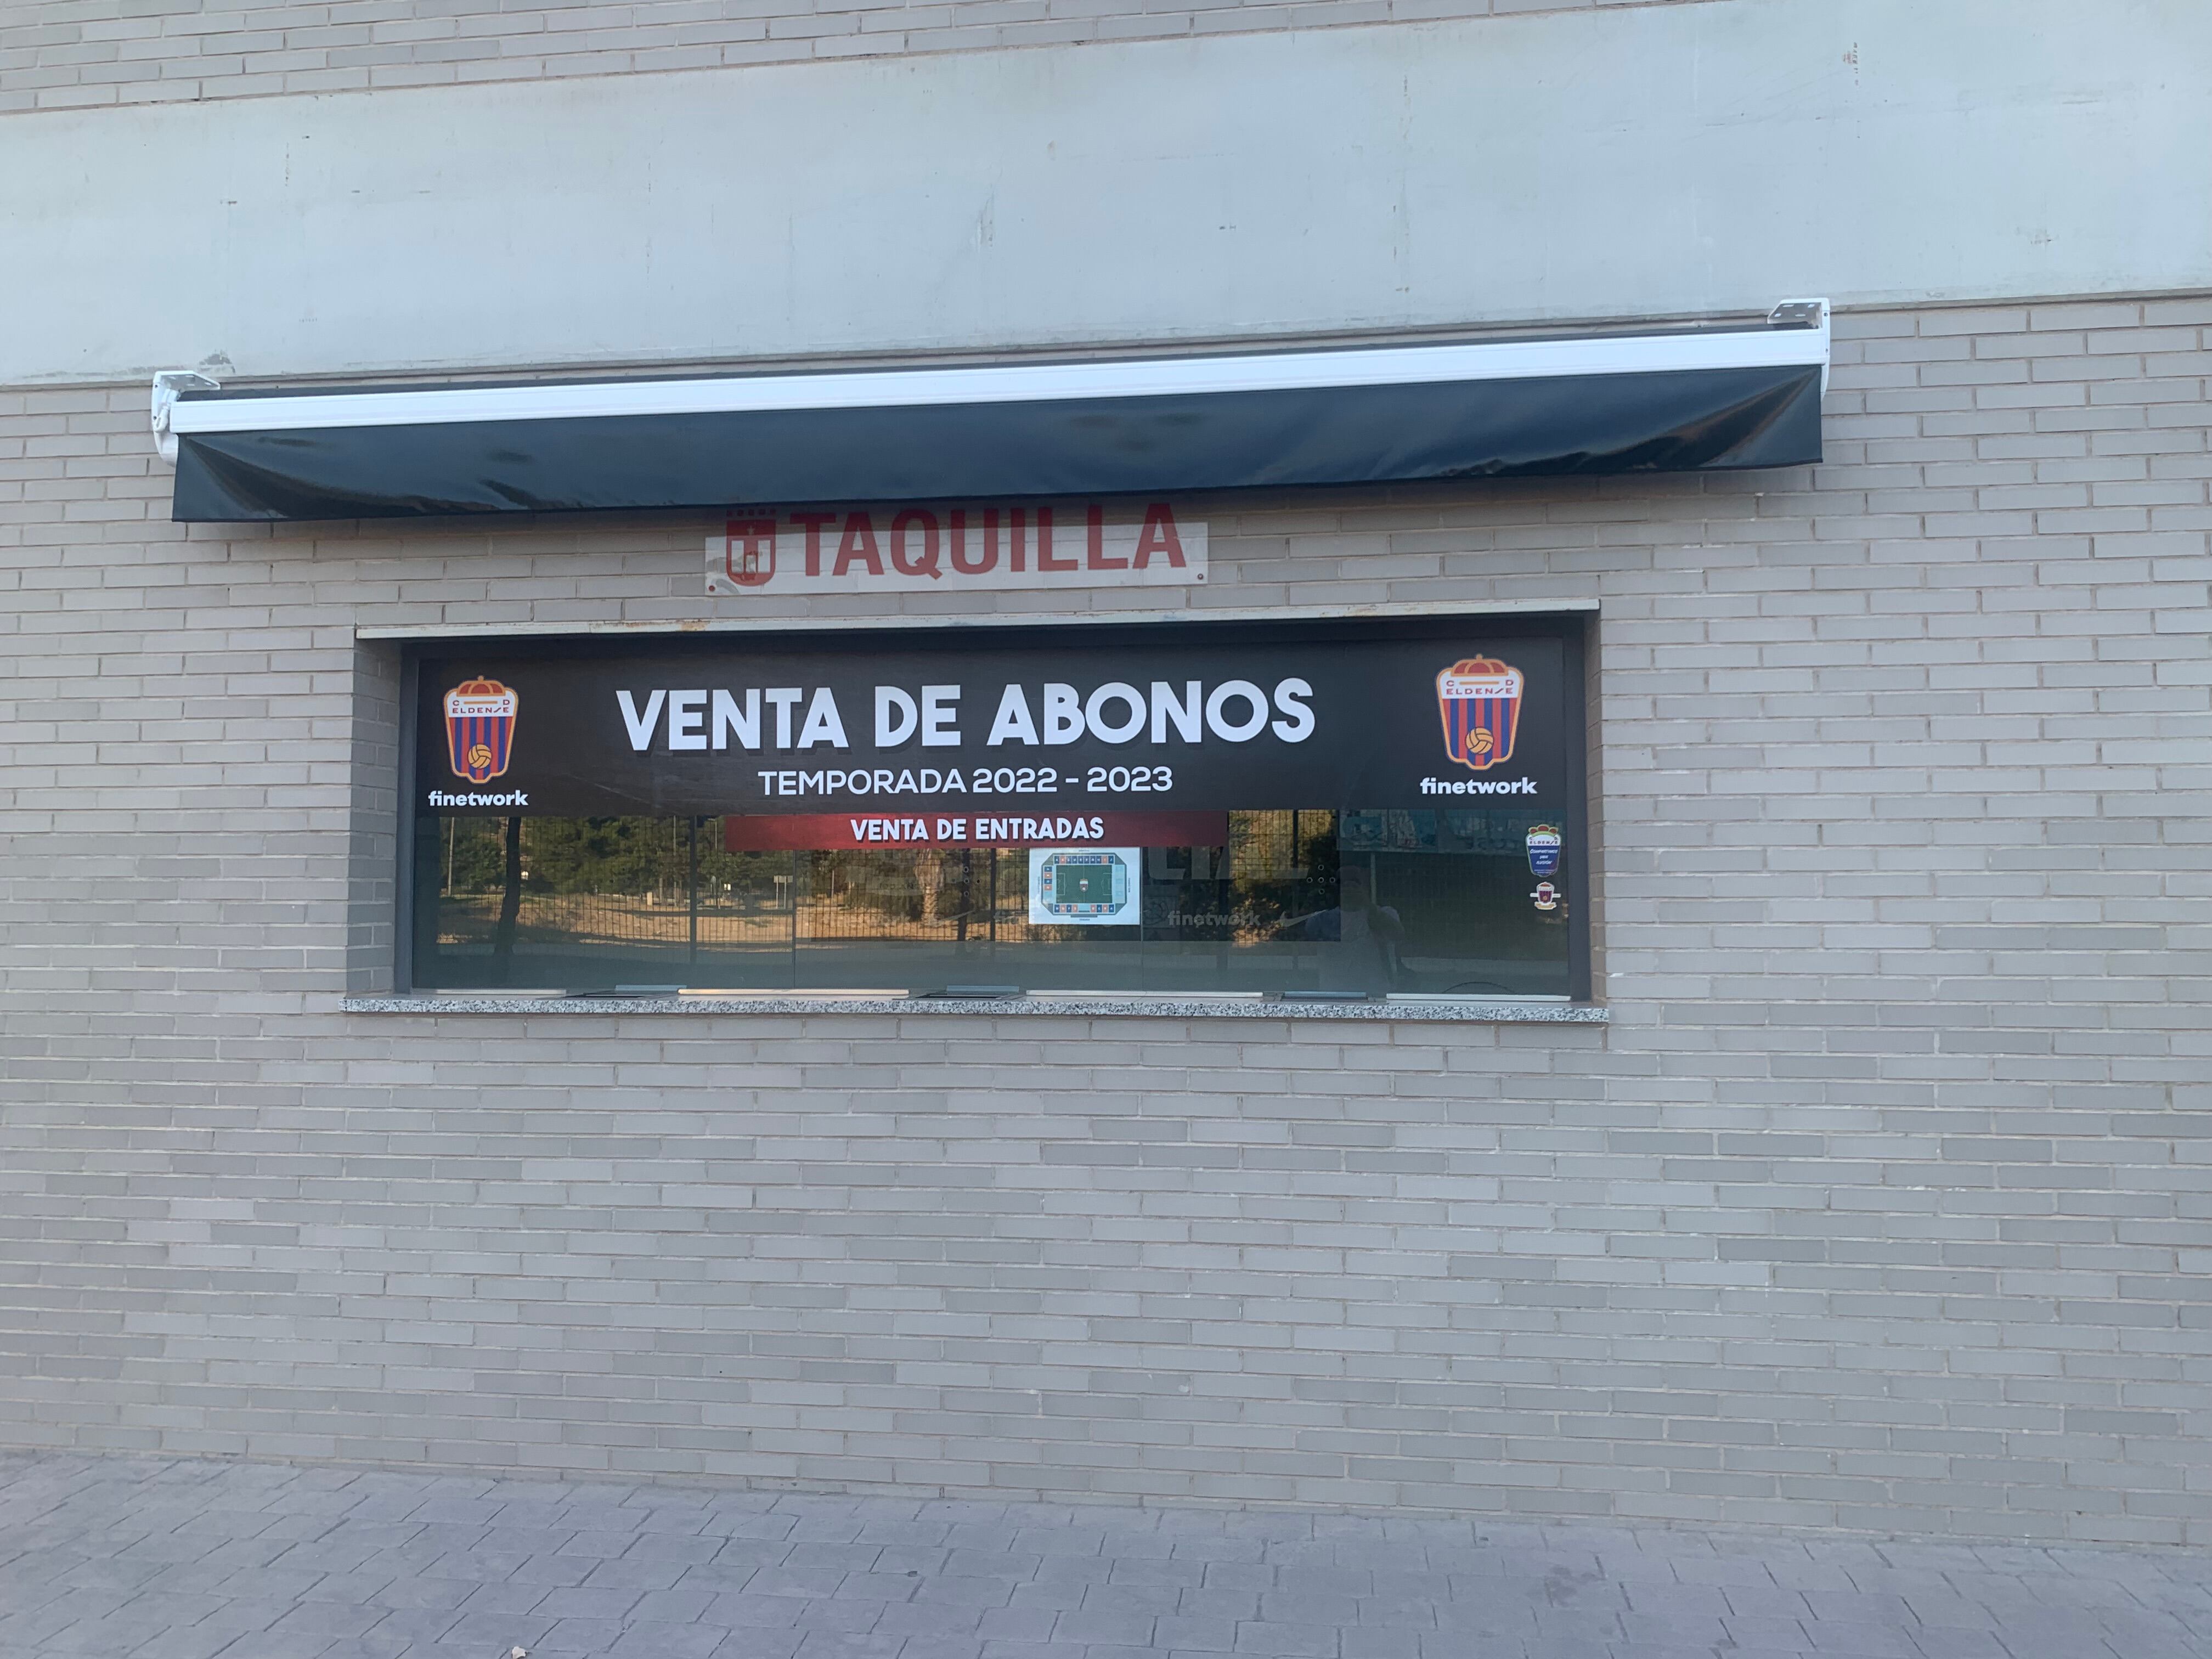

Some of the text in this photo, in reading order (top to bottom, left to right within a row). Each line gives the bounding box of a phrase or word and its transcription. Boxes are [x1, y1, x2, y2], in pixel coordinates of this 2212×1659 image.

[790, 503, 1187, 580] TAQUILLA
[616, 678, 1315, 751] VENTA DE ABONOS
[758, 769, 967, 795] TEMPORADA
[973, 768, 1057, 793] 2022
[1087, 766, 1173, 792] 2023
[1420, 776, 1538, 795] finetwork
[428, 789, 529, 806] finetwork
[850, 816, 1104, 840] VENTA DE ENTRADAS
[1167, 910, 1261, 927] finetwork
